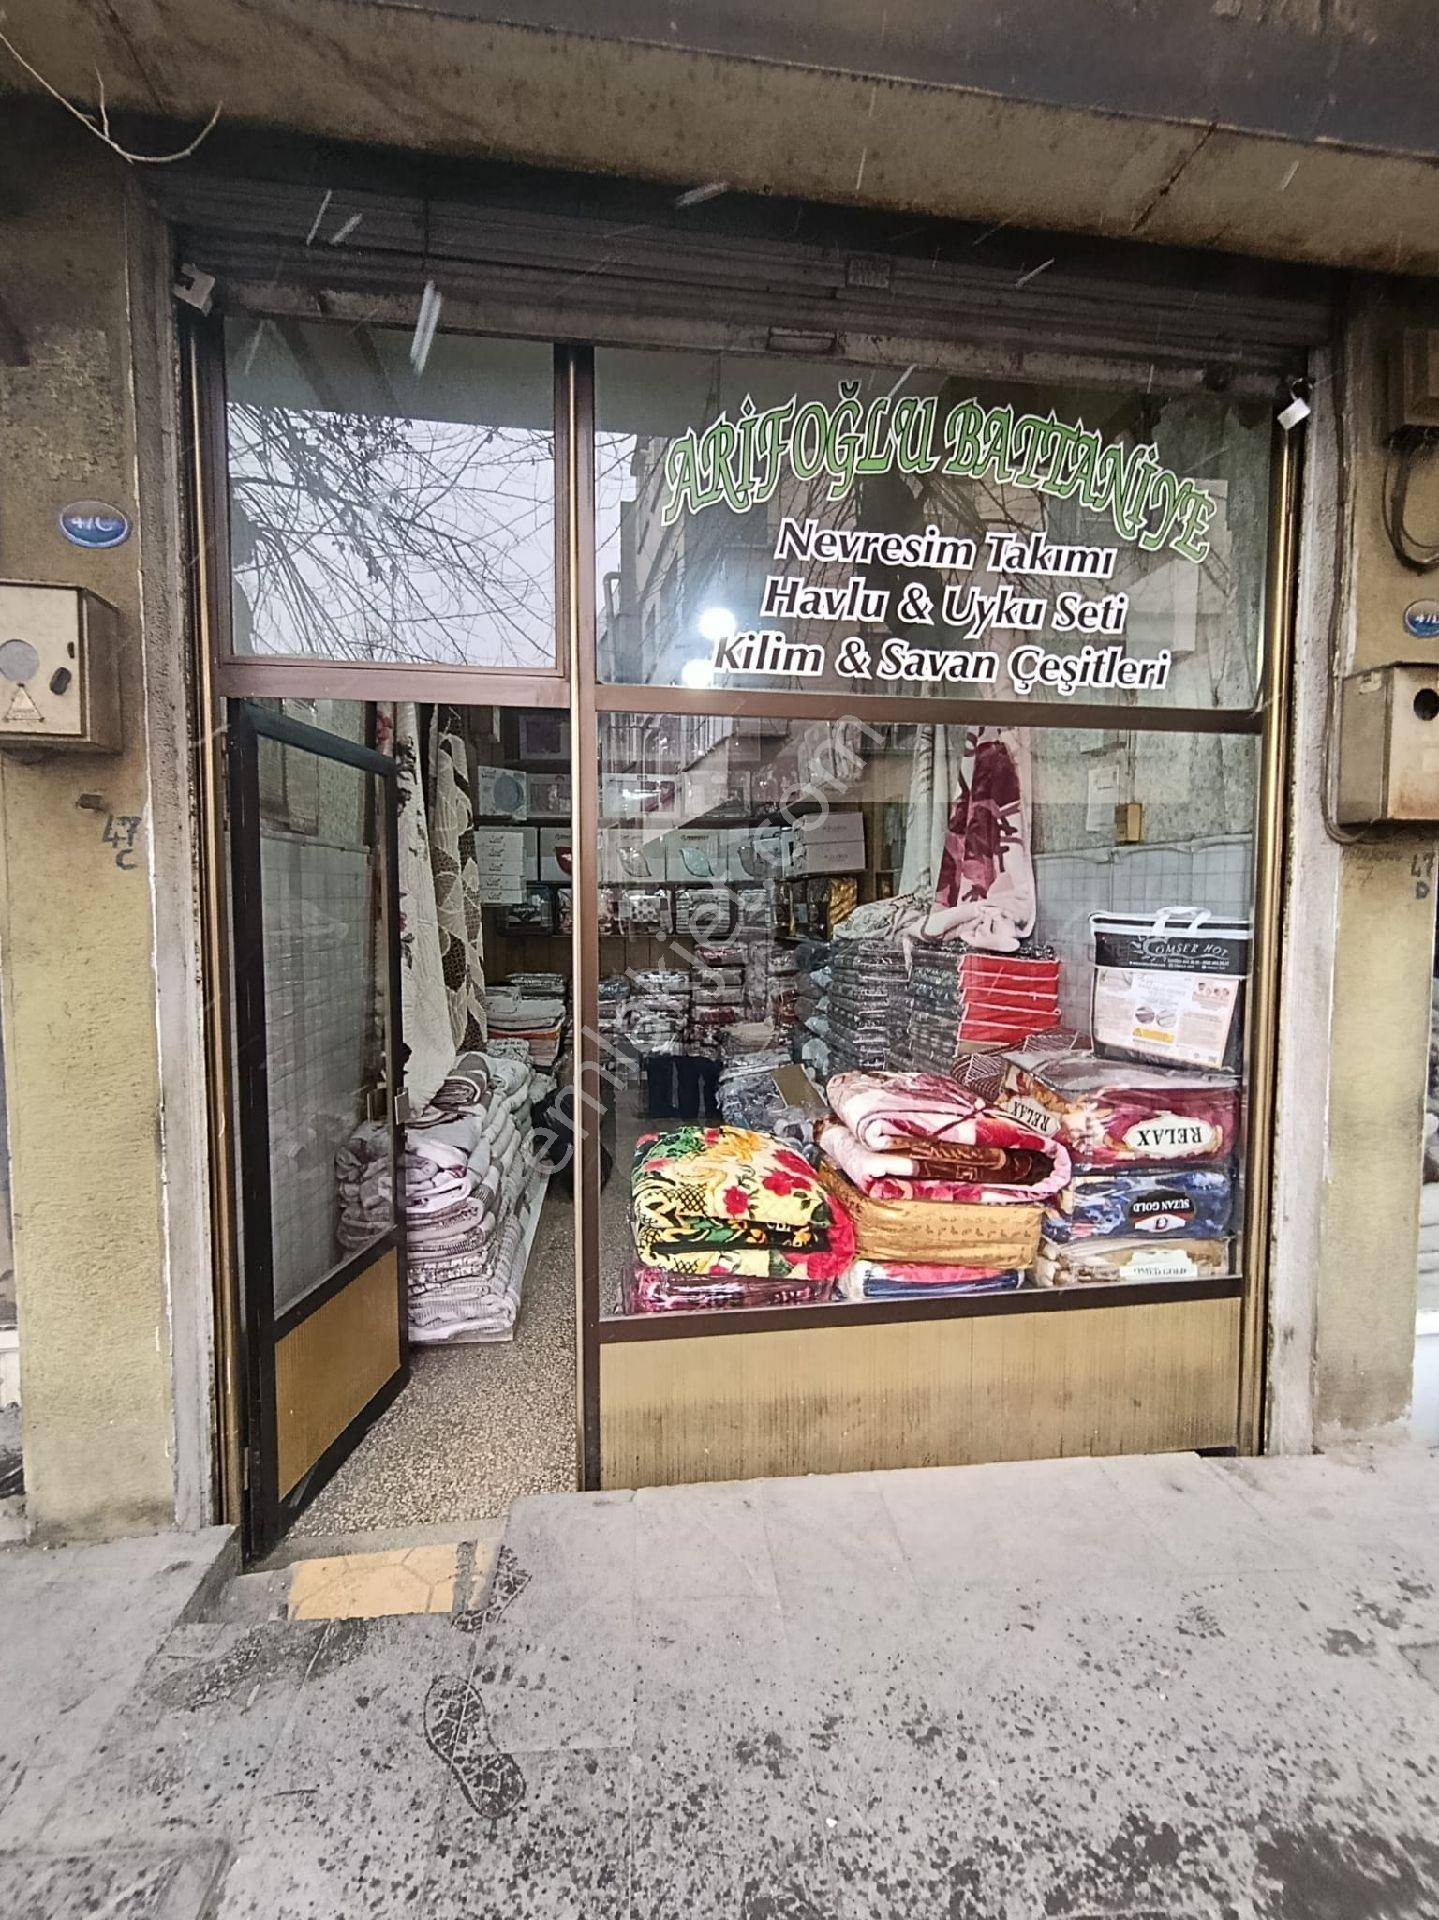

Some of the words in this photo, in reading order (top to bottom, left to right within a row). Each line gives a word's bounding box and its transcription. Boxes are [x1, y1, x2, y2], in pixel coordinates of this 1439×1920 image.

[662, 380, 938, 525] ARİFOĞLU
[944, 398, 1216, 562] BATTANİYE
[776, 518, 975, 568] Nevresim
[986, 535, 1117, 577] Takımı
[761, 575, 889, 621] Havlu
[898, 583, 934, 623] &
[942, 585, 1045, 639] Uyku
[1054, 592, 1127, 634] Seti
[715, 632, 824, 678] Kilim
[837, 641, 872, 679] &
[879, 641, 1001, 685] Savan
[1009, 643, 1172, 695] Çeşitleri
[1011, 1101, 1050, 1132] RELAX
[1137, 1126, 1202, 1146] RELAX
[1133, 1202, 1160, 1212] GOLD
[1162, 1198, 1190, 1210] SUZAN
